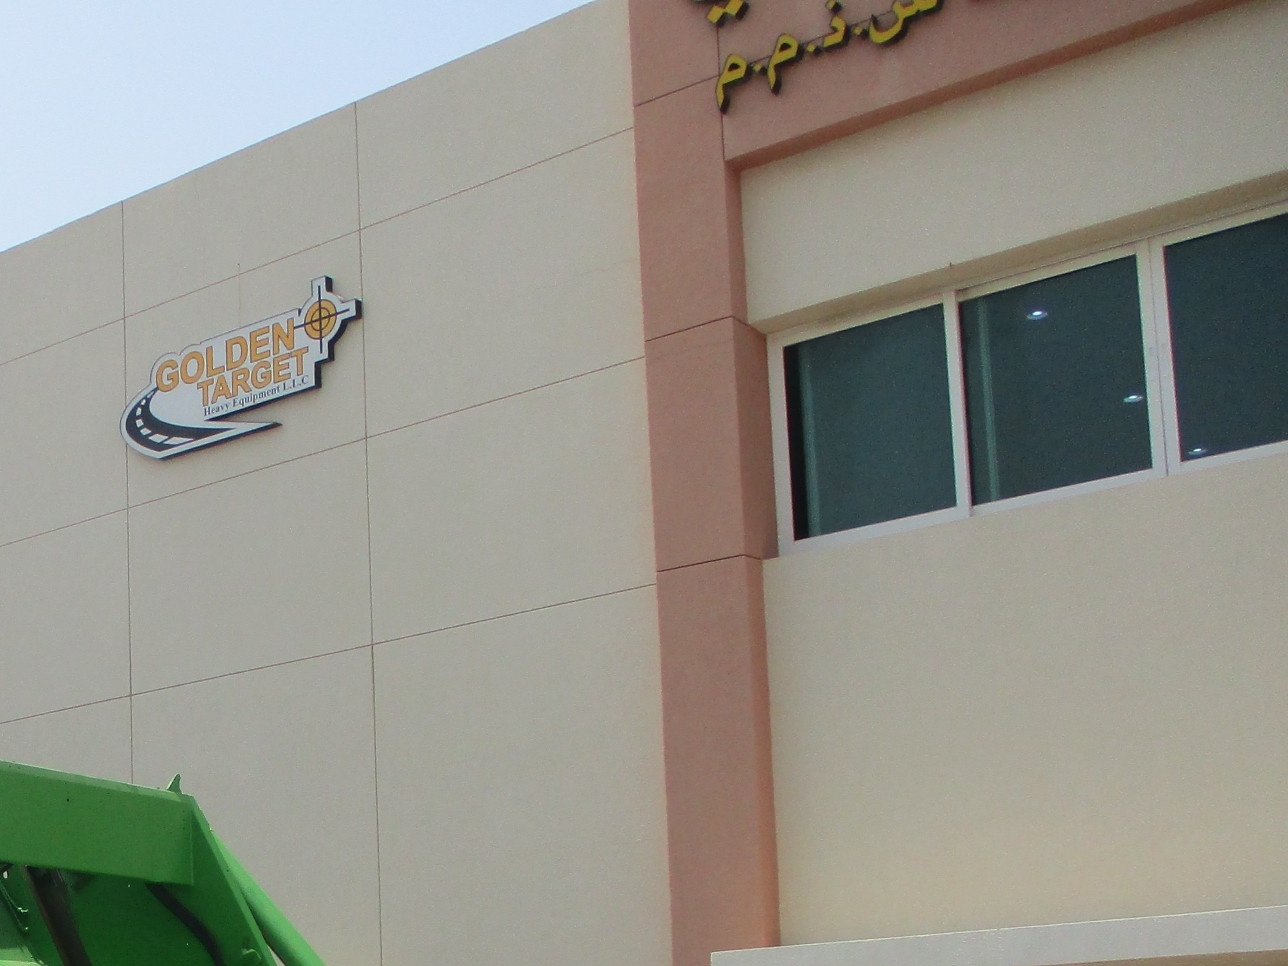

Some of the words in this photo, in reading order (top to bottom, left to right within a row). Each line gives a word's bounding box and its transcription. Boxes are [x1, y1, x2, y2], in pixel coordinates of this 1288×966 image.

[156, 318, 295, 392] GOLDEN
[197, 346, 309, 407] TARGET
[203, 401, 230, 417] Heavy
[232, 386, 281, 407] Equipment
[282, 374, 309, 391] L.L.C
